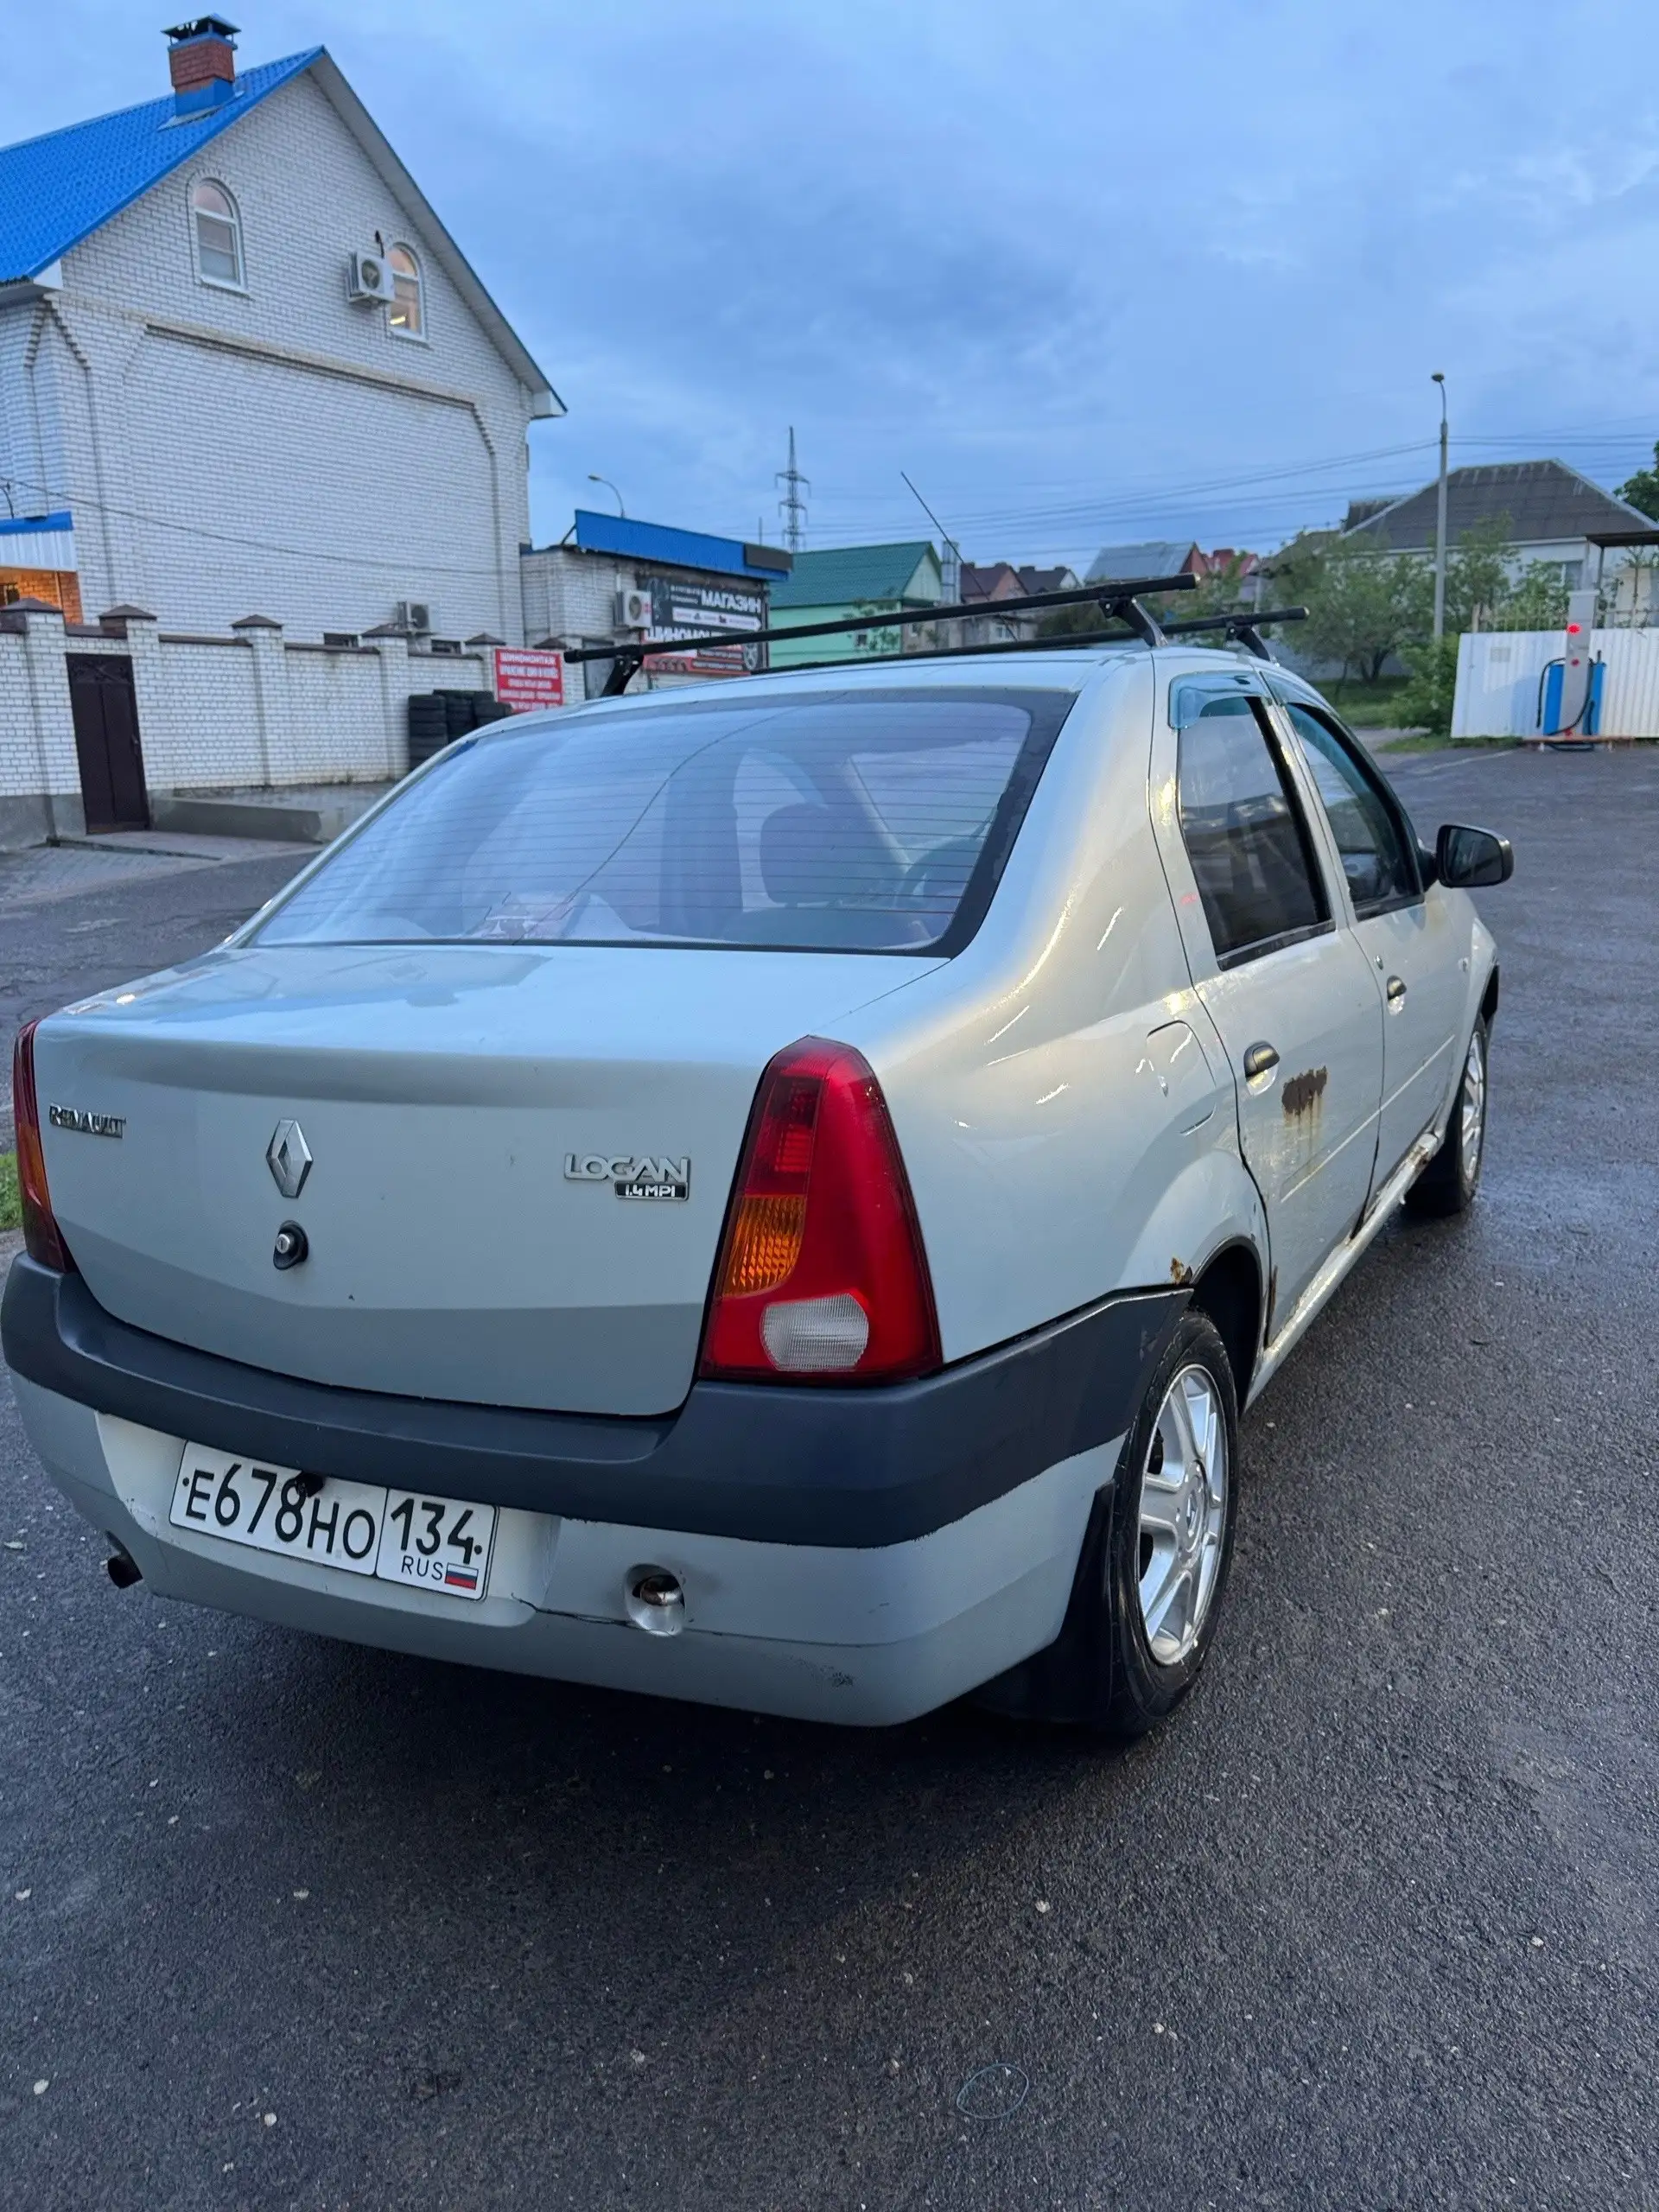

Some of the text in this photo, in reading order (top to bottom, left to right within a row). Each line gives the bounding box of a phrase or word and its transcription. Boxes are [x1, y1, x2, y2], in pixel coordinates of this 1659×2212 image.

[701, 588, 762, 613] МАГАЗИН
[49, 1103, 126, 1139] RENAULT
[564, 1154, 690, 1183] LOGAN
[390, 1497, 474, 1565] 134
[400, 1554, 444, 1581] RUS
